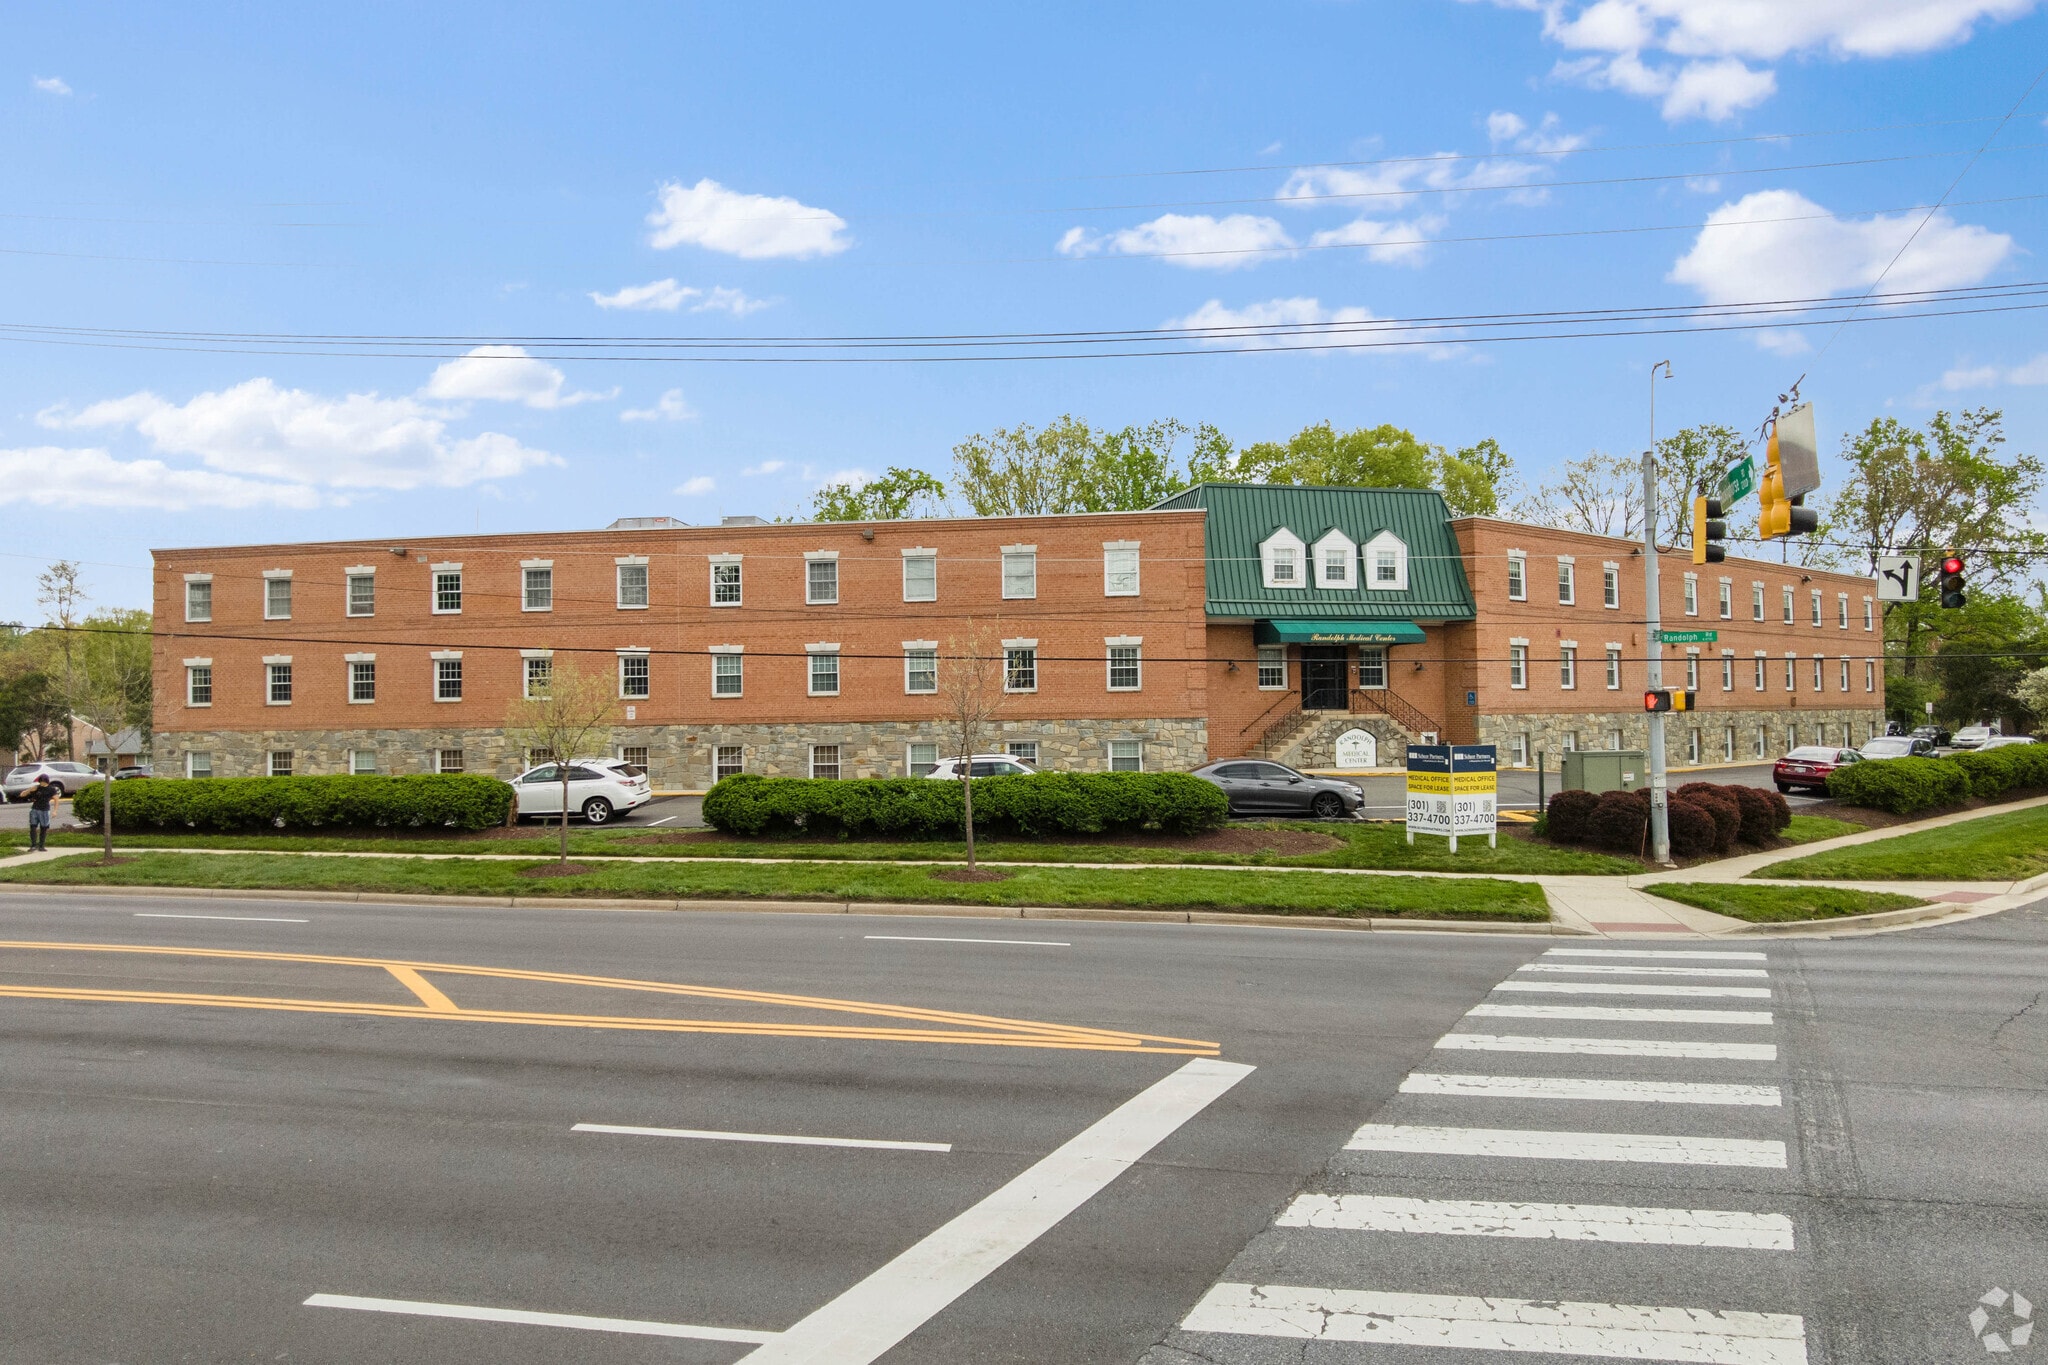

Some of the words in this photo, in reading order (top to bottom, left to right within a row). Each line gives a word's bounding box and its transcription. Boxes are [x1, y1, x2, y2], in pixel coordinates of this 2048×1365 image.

[1311, 633, 1345, 642] Randolph
[1663, 634, 1698, 642] Randolph
[1339, 735, 1372, 745] RANDOLPH
[1408, 800, 1429, 812] (301)
[1454, 802, 1476, 813] (301)
[1408, 812, 1450, 825] 337-4700
[1454, 813, 1495, 825] 337-4700
